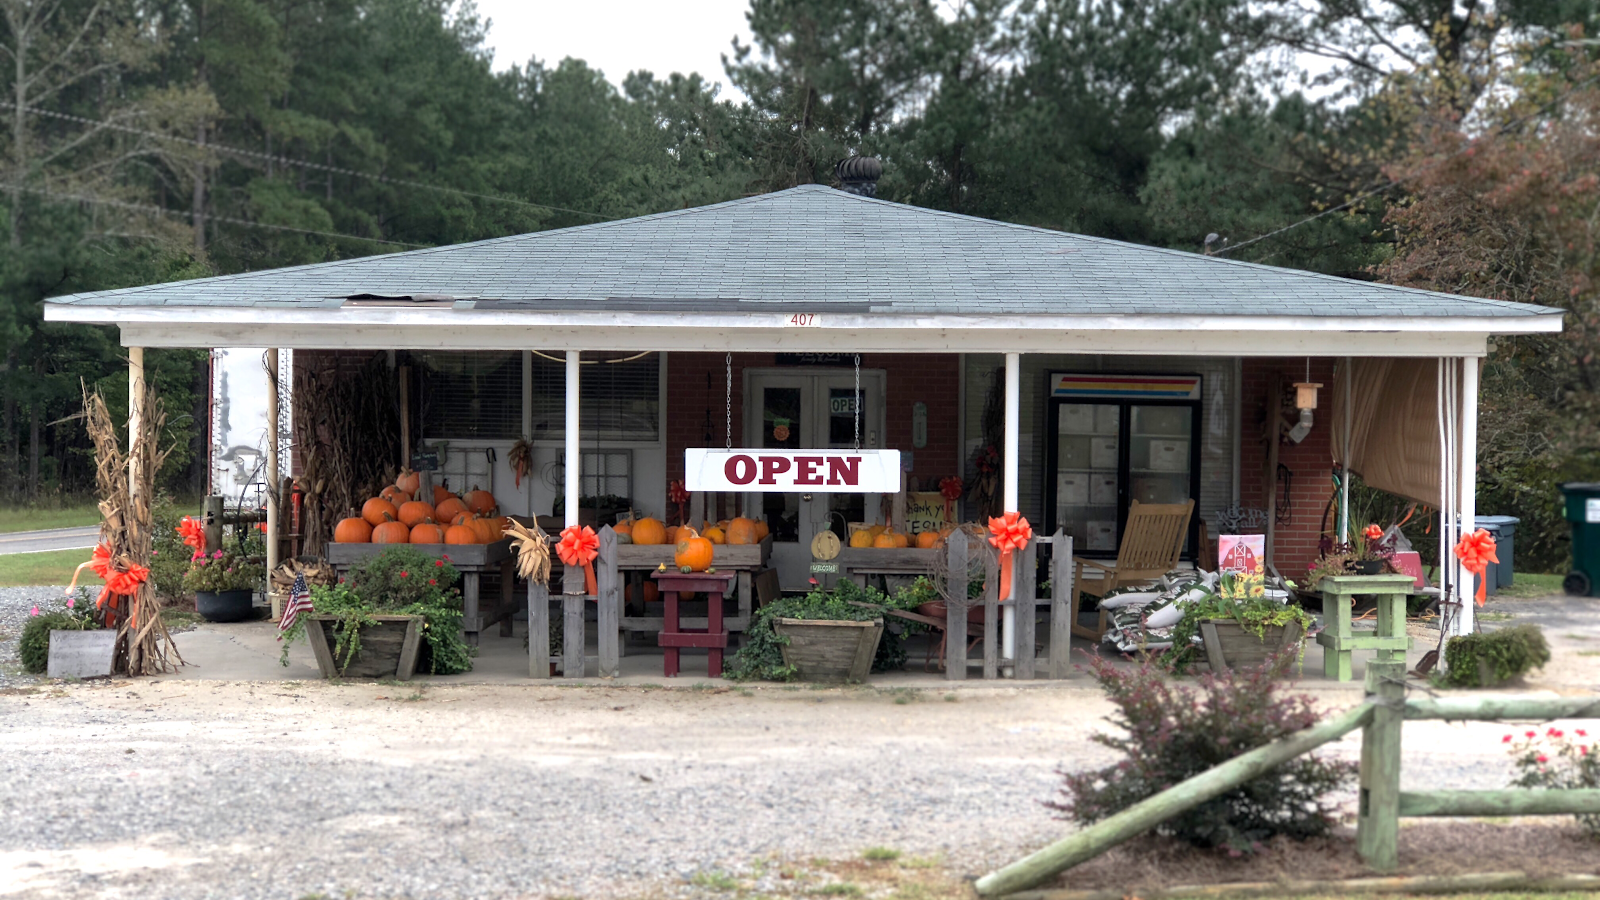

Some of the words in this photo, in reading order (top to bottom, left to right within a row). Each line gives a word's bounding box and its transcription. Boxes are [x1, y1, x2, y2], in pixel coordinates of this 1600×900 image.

[791, 313, 814, 326] 407
[724, 454, 862, 486] OPEN
[906, 500, 932, 517] hank
